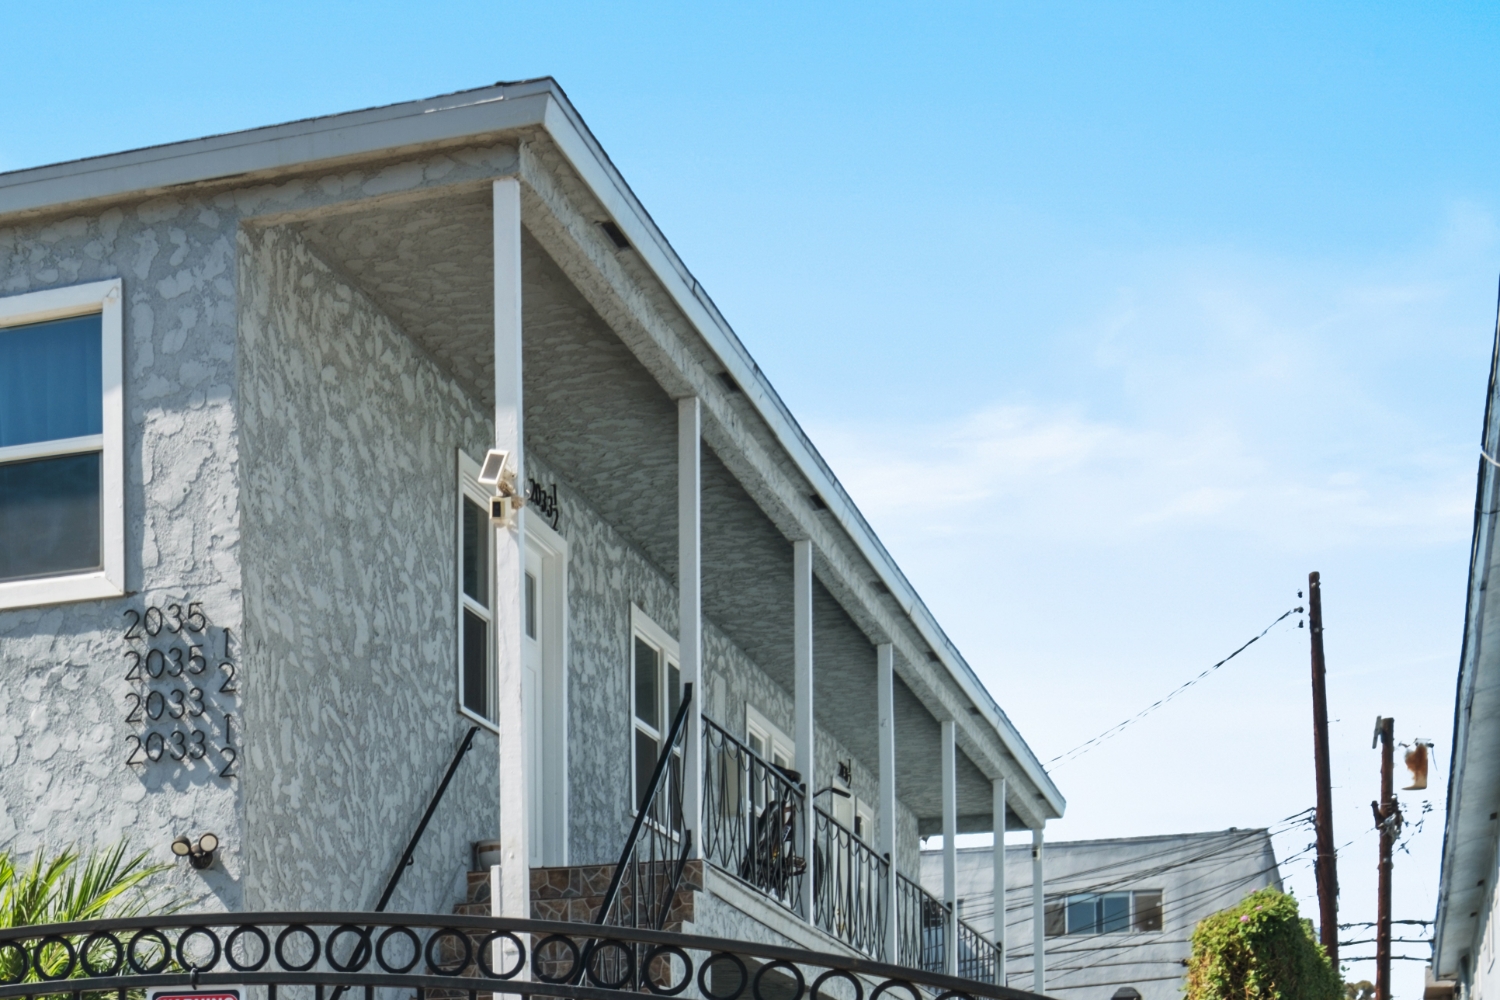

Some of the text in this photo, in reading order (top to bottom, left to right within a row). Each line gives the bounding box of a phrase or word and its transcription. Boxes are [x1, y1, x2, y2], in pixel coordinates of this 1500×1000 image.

[123, 602, 206, 640] 2035
[124, 627, 237, 694] 2035 1 2
[124, 687, 206, 723] 2033
[125, 713, 238, 778] 2033 1 2
